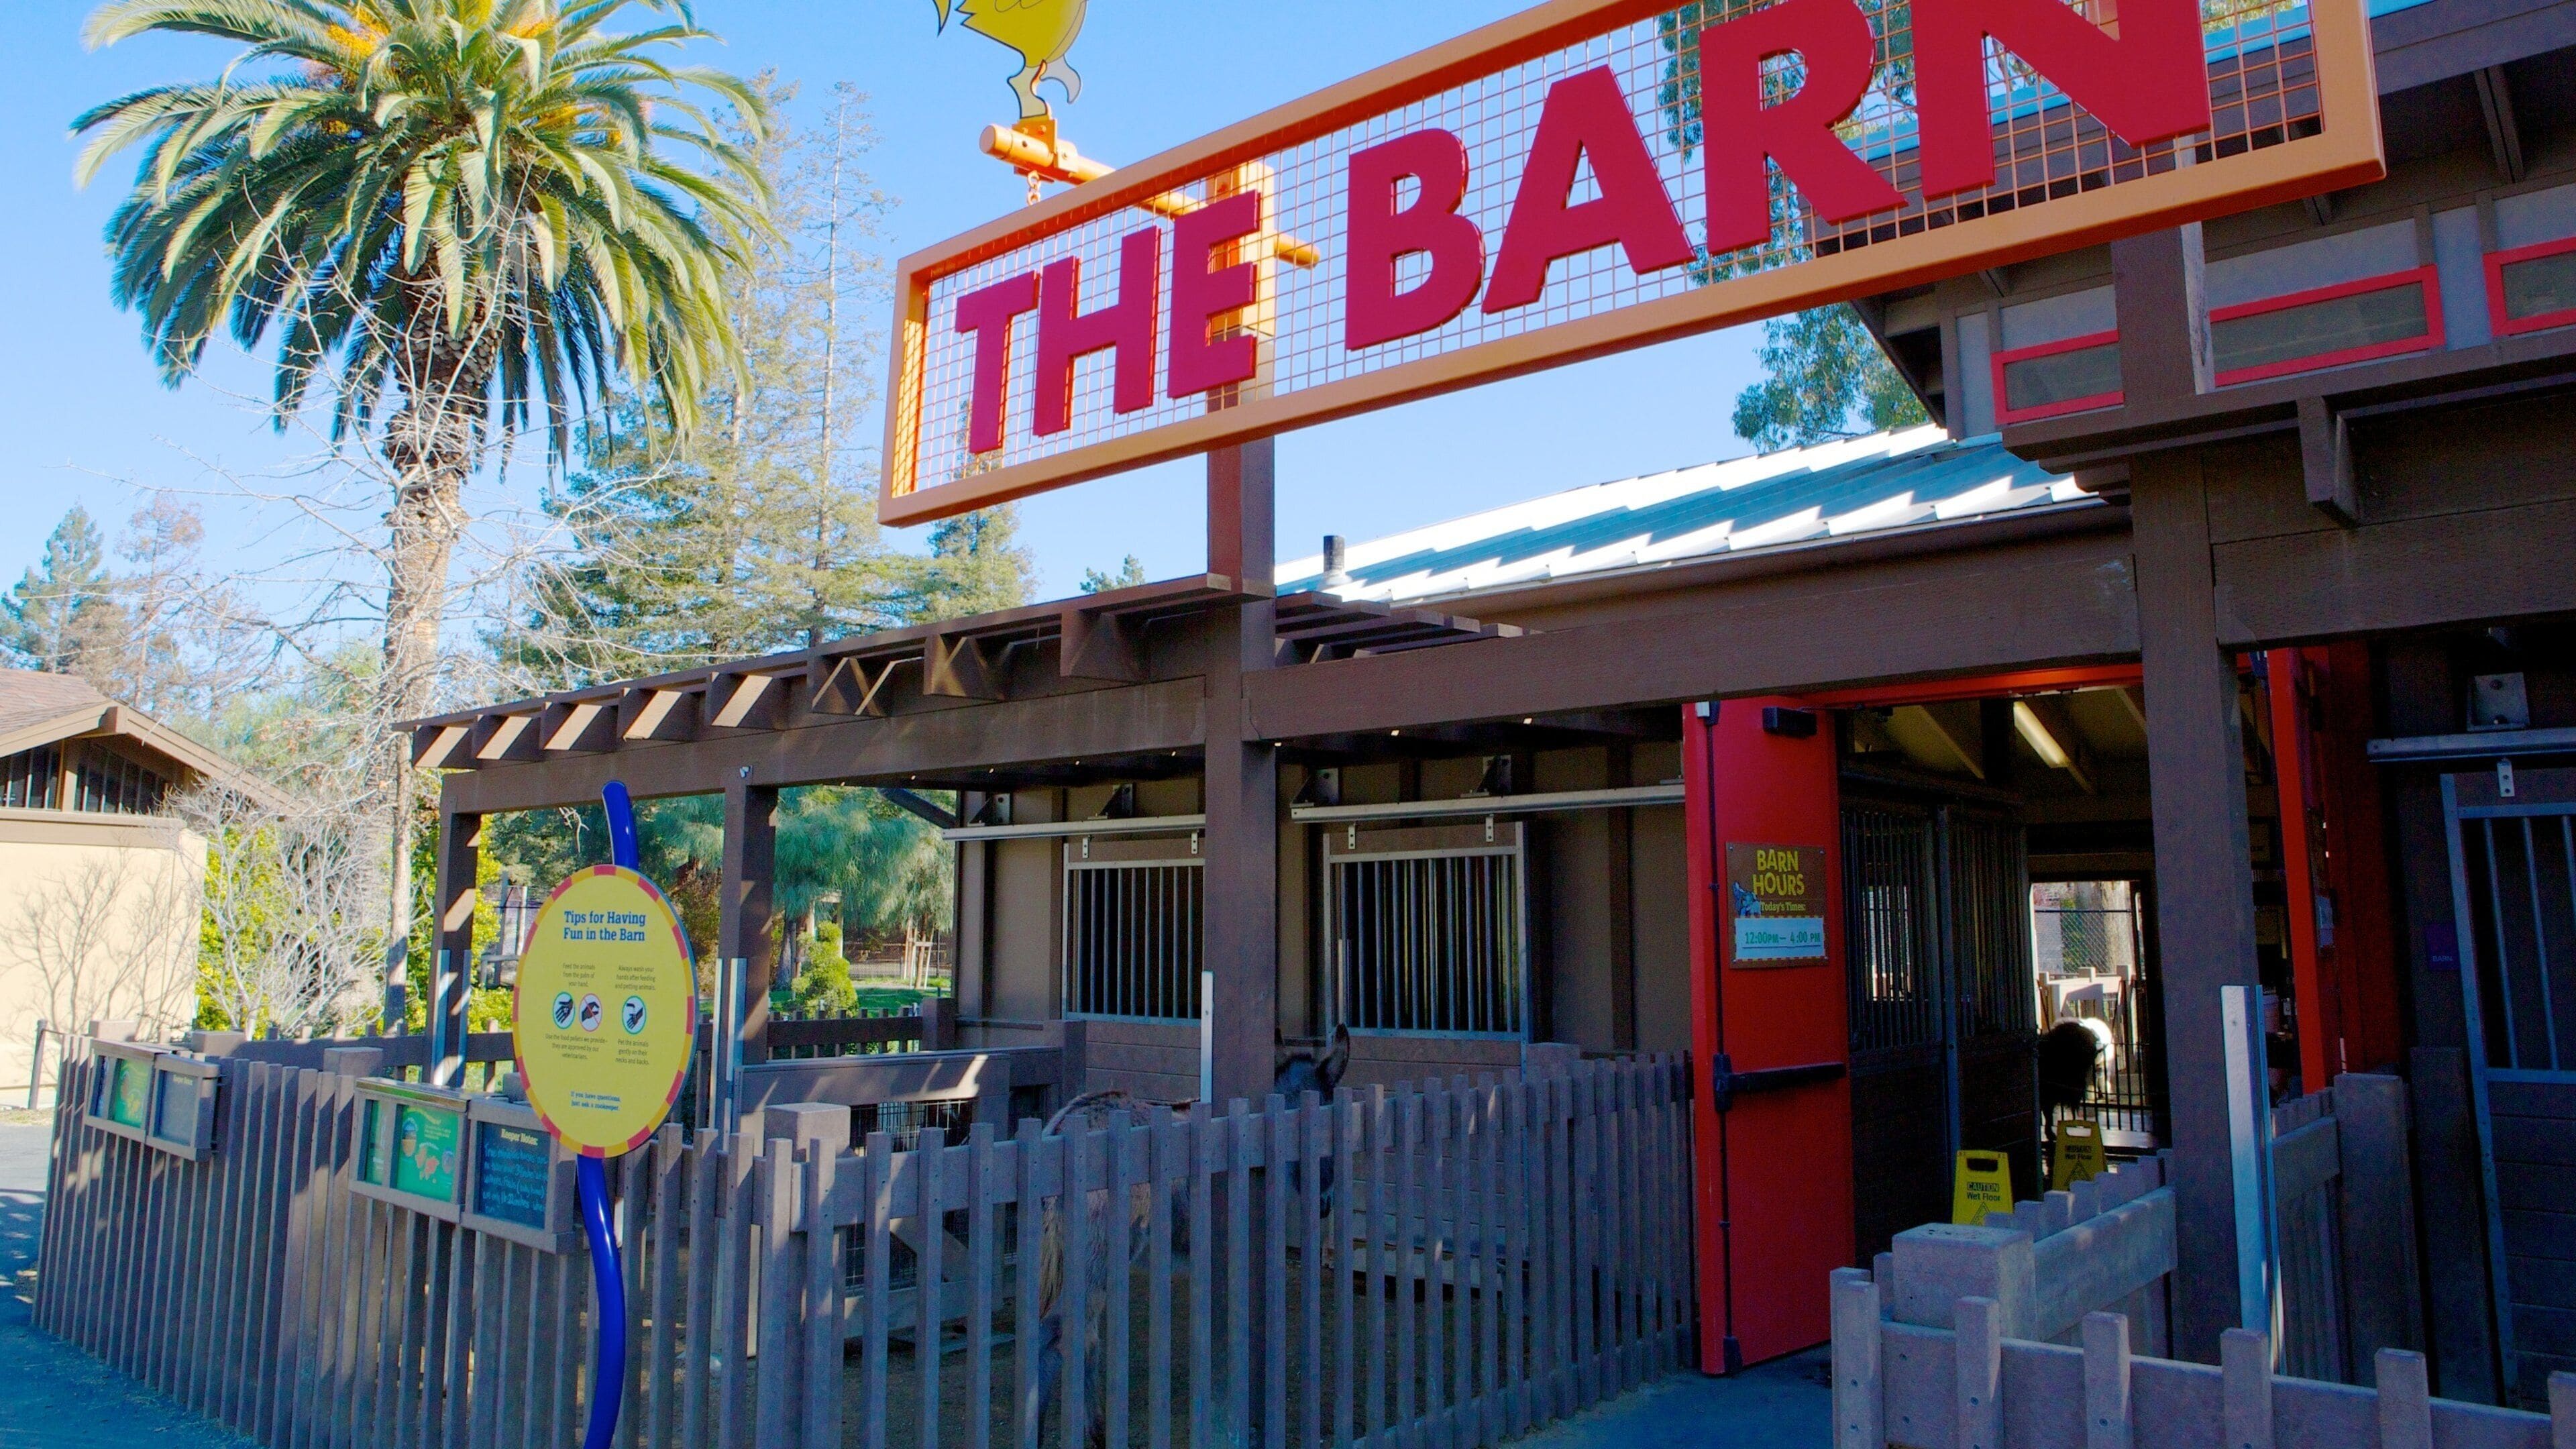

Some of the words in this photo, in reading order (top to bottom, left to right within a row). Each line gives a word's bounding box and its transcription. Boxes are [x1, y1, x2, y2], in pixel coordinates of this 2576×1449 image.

[955, 189, 1261, 454] THE
[1346, 0, 2211, 351] BARN
[1756, 849, 1799, 872] BARN
[1752, 872, 1805, 896] HOURS
[1760, 901, 1785, 912] Today's
[1785, 902, 1807, 912] Times:
[564, 910, 586, 926] Tips
[589, 910, 604, 924] for
[607, 911, 646, 927] Having
[564, 927, 583, 940] Fun
[586, 927, 596, 940] in
[600, 928, 616, 941] the
[619, 928, 645, 941] Barn
[1790, 931, 1808, 944] 4:00
[1811, 933, 1821, 943] PM
[568, 1043, 586, 1051] approved
[500, 1128, 520, 1142] Keeper
[1967, 1182, 2000, 1192] CAUTION
[1967, 1191, 1980, 1200] Wet
[1982, 1193, 2000, 1201] Floor
